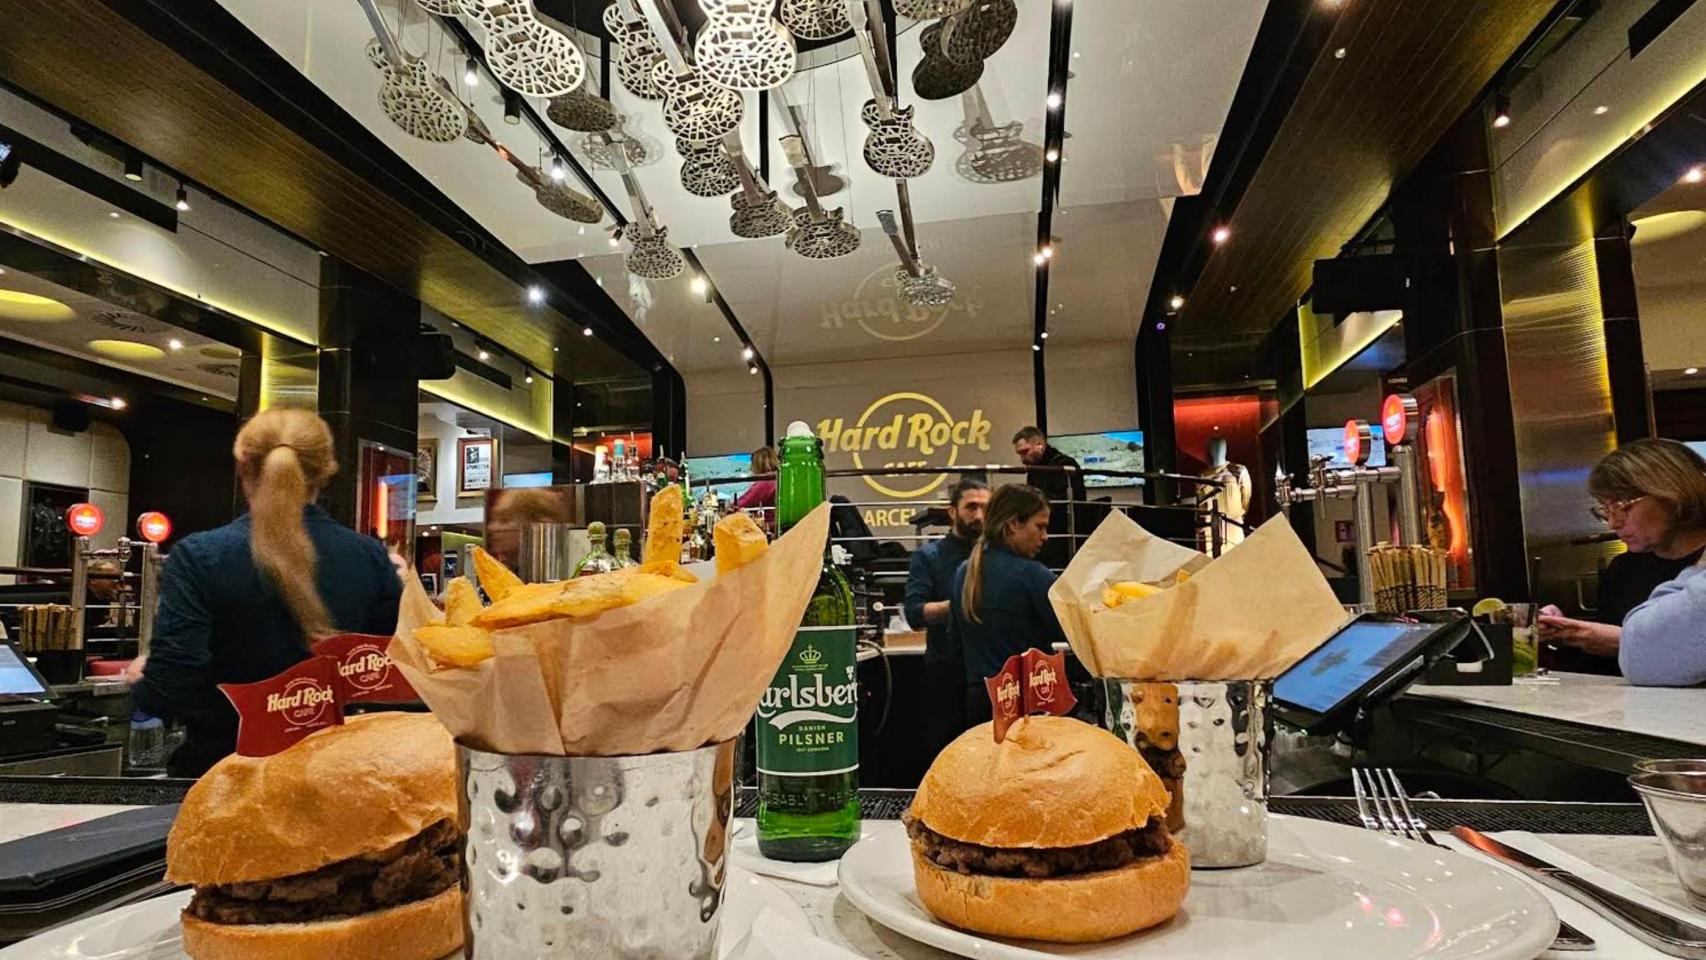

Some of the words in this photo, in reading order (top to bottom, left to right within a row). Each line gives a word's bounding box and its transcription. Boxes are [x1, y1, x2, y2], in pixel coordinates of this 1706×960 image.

[817, 414, 904, 452] Hard
[907, 409, 992, 455] Rock
[337, 656, 366, 677] ard
[267, 690, 302, 712] Hard
[303, 685, 335, 707] Rock
[779, 732, 844, 746] PILSNER
